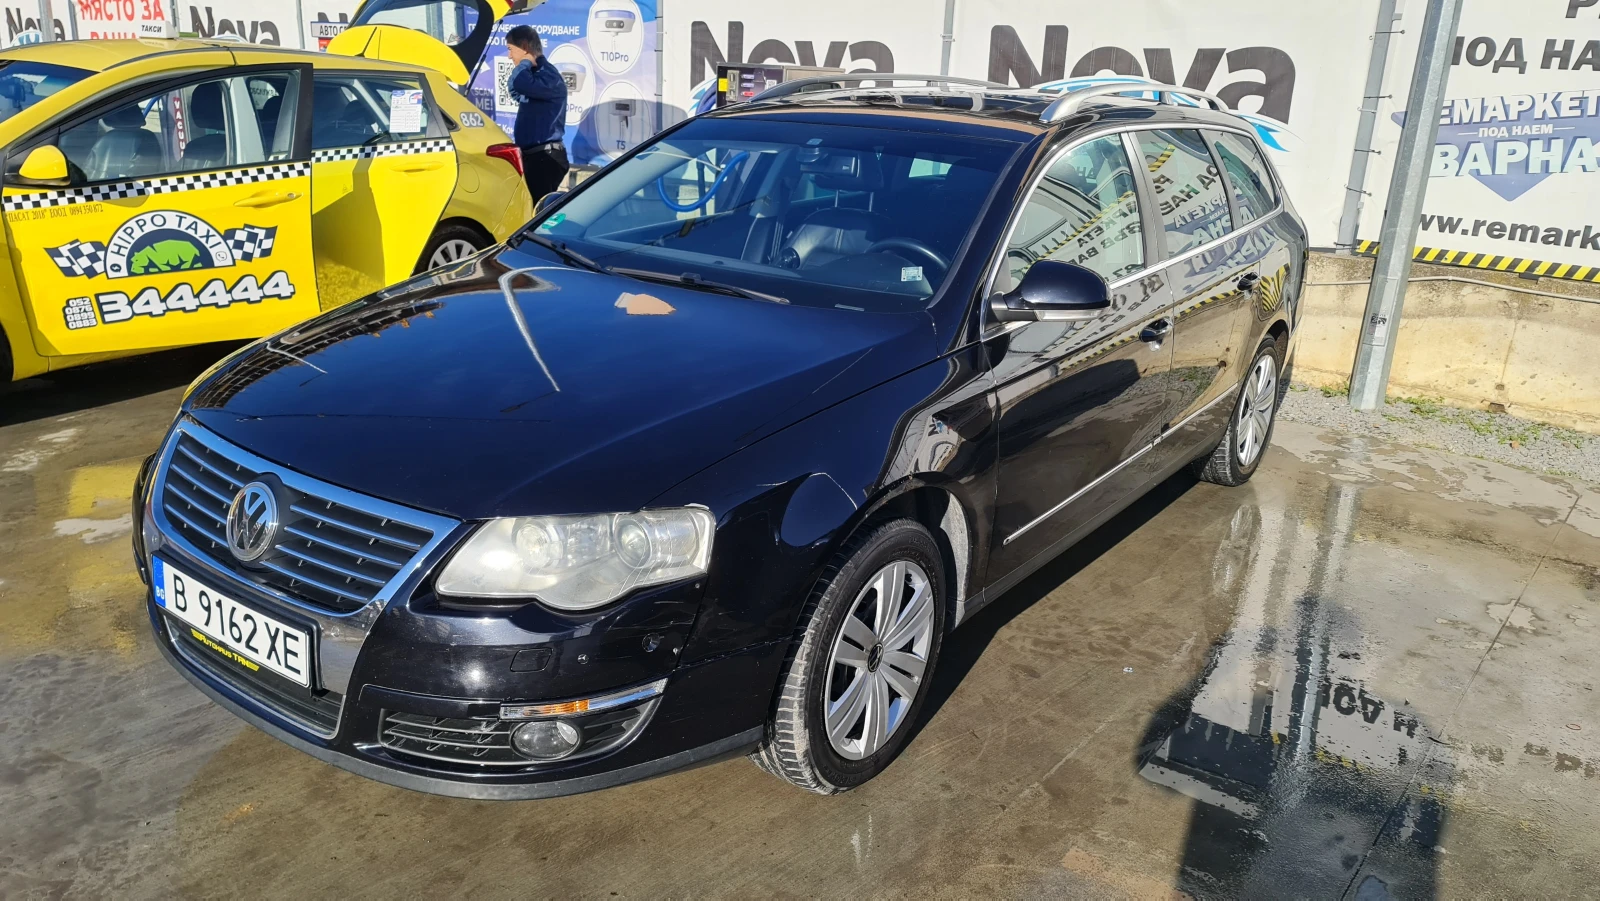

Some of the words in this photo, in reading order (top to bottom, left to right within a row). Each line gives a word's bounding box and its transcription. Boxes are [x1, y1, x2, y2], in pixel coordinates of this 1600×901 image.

[141, 24, 162, 33] ТАКСИ
[319, 25, 338, 37] АВТО
[600, 51, 629, 63] T10Pro
[460, 112, 484, 127] 862
[1478, 127, 1509, 138] ПОД
[1512, 124, 1554, 135] НАЕМ
[616, 140, 626, 150] T5
[1429, 137, 1599, 178] ВАРНА
[117, 213, 167, 257] HIPPO
[175, 214, 222, 250] TAXI
[68, 297, 91, 307] 052
[98, 270, 295, 322] 344444
[155, 584, 165, 601] BG
[198, 589, 260, 655] 9162
